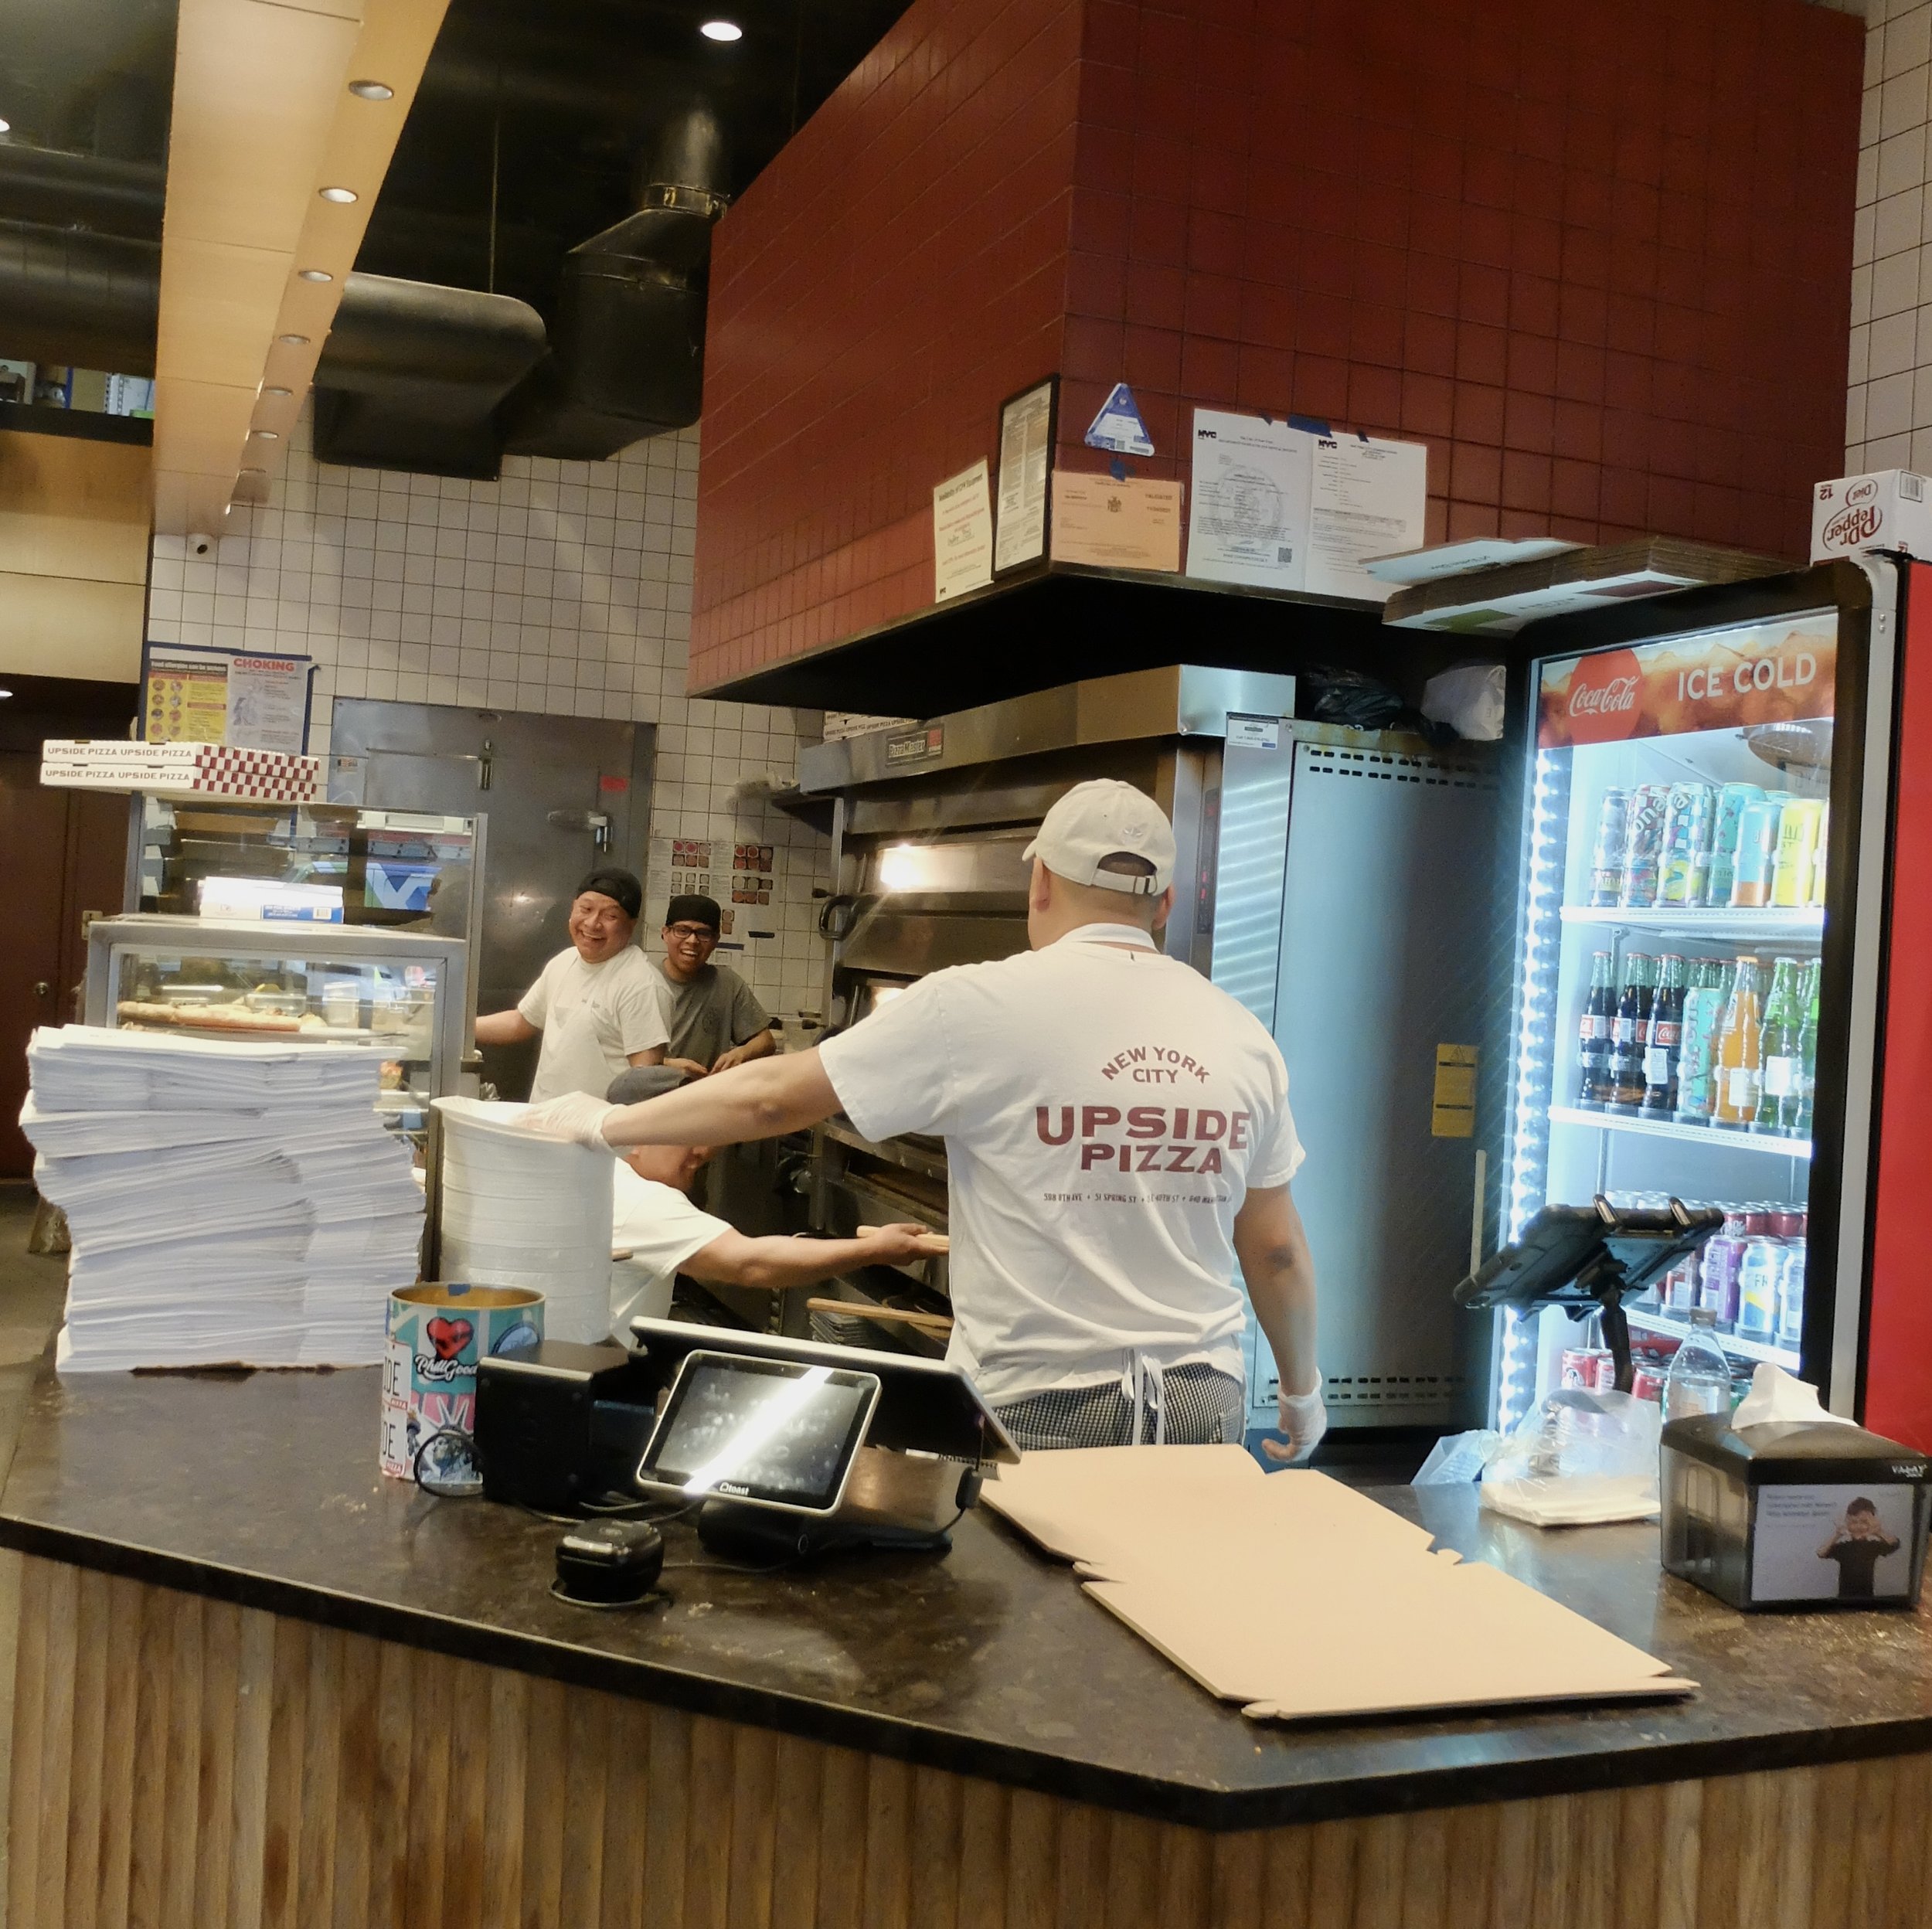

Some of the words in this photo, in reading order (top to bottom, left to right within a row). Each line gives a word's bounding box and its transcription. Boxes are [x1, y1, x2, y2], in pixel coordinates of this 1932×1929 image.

[1198, 430, 1216, 438] NYC
[1318, 440, 1337, 449] NYC
[1819, 488, 1834, 501] 12
[1852, 484, 1872, 501] Diet
[1826, 505, 1876, 541] Pepper
[1839, 526, 1860, 546] Dr
[233, 658, 294, 672] CHOKING
[1678, 667, 1723, 702] ICE
[1733, 652, 1817, 691] COLD
[1569, 675, 1640, 717] Coca-Cola
[1101, 1046, 1146, 1080] NEW
[1152, 1046, 1211, 1084] YORK
[1132, 1069, 1179, 1084] CITY
[1036, 1105, 1251, 1150] UPSIDE
[1080, 1143, 1223, 1174] PIZZA
[1104, 1193, 1127, 1203] SPRING
[728, 1484, 749, 1496] toast
